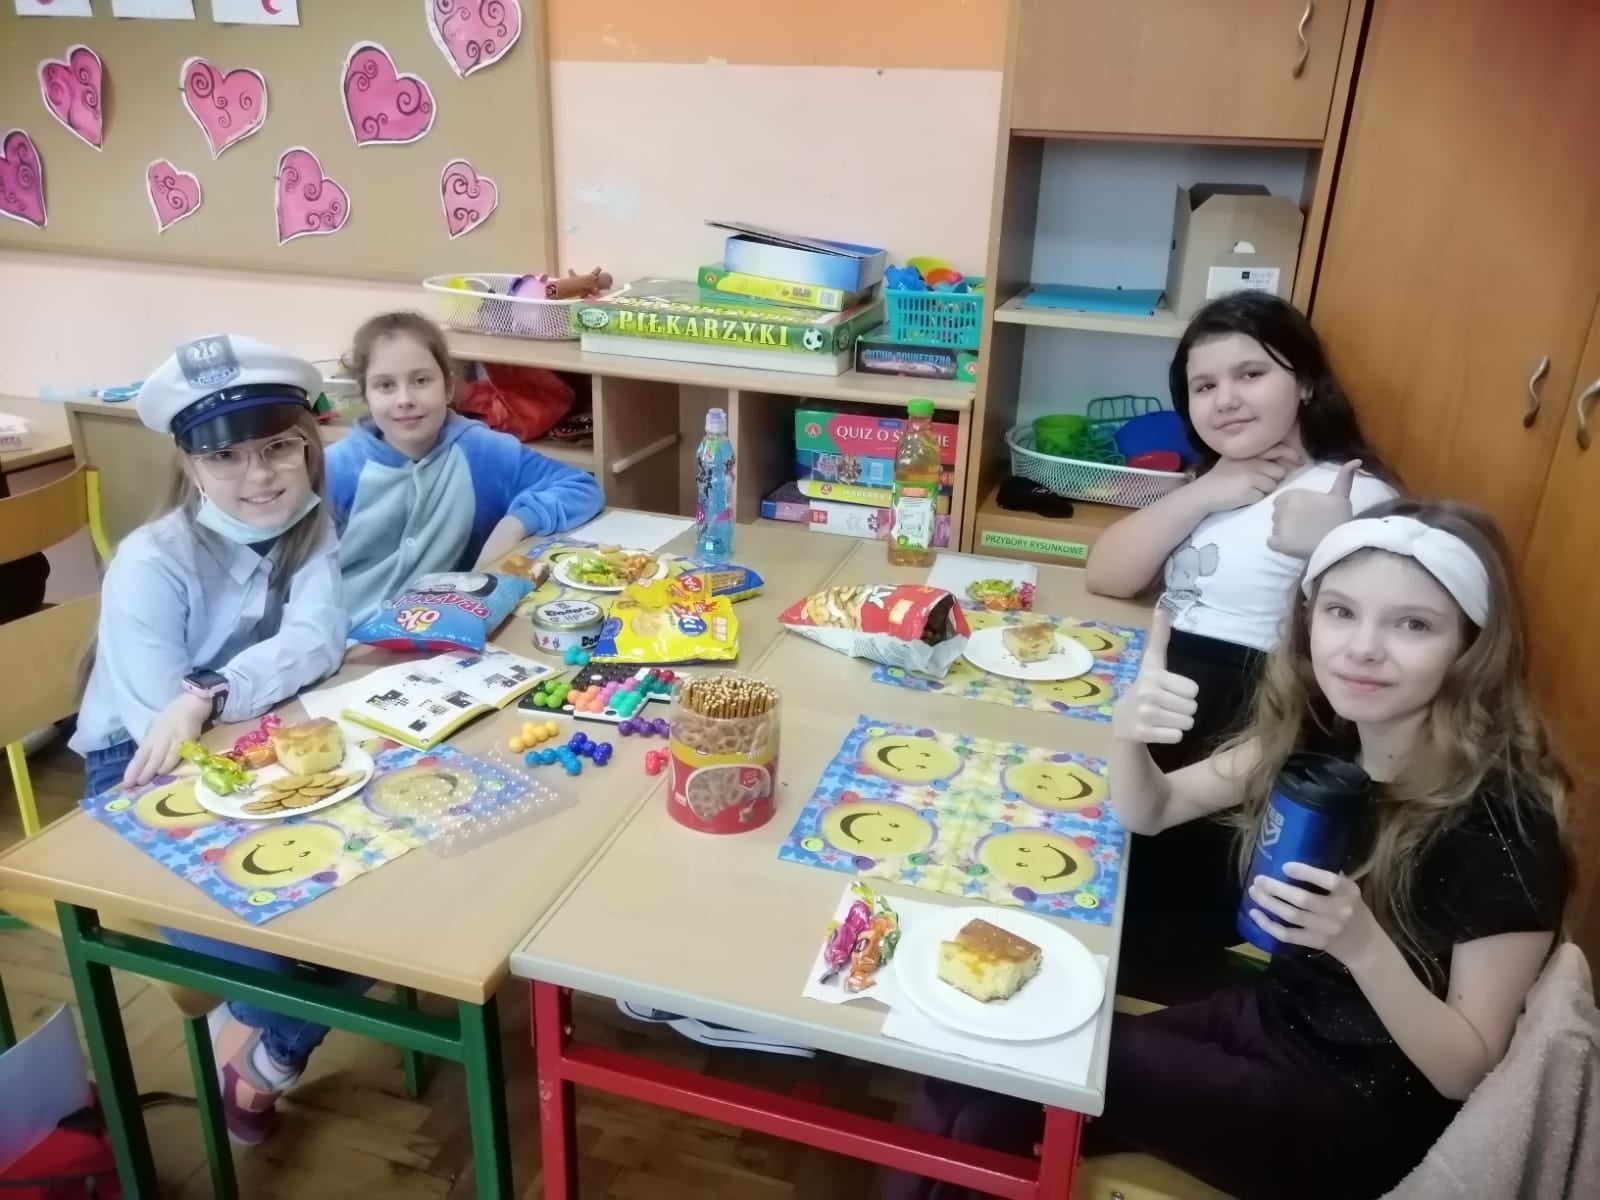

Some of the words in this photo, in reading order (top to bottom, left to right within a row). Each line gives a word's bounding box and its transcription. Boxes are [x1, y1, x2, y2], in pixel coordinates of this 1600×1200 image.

[618, 310, 789, 347] PIŁKARZYKI
[836, 425, 873, 440] QUIZ
[877, 430, 889, 441] O
[985, 534, 1029, 547] PRZYBORY
[1030, 541, 1084, 555] RYSUNKOWE
